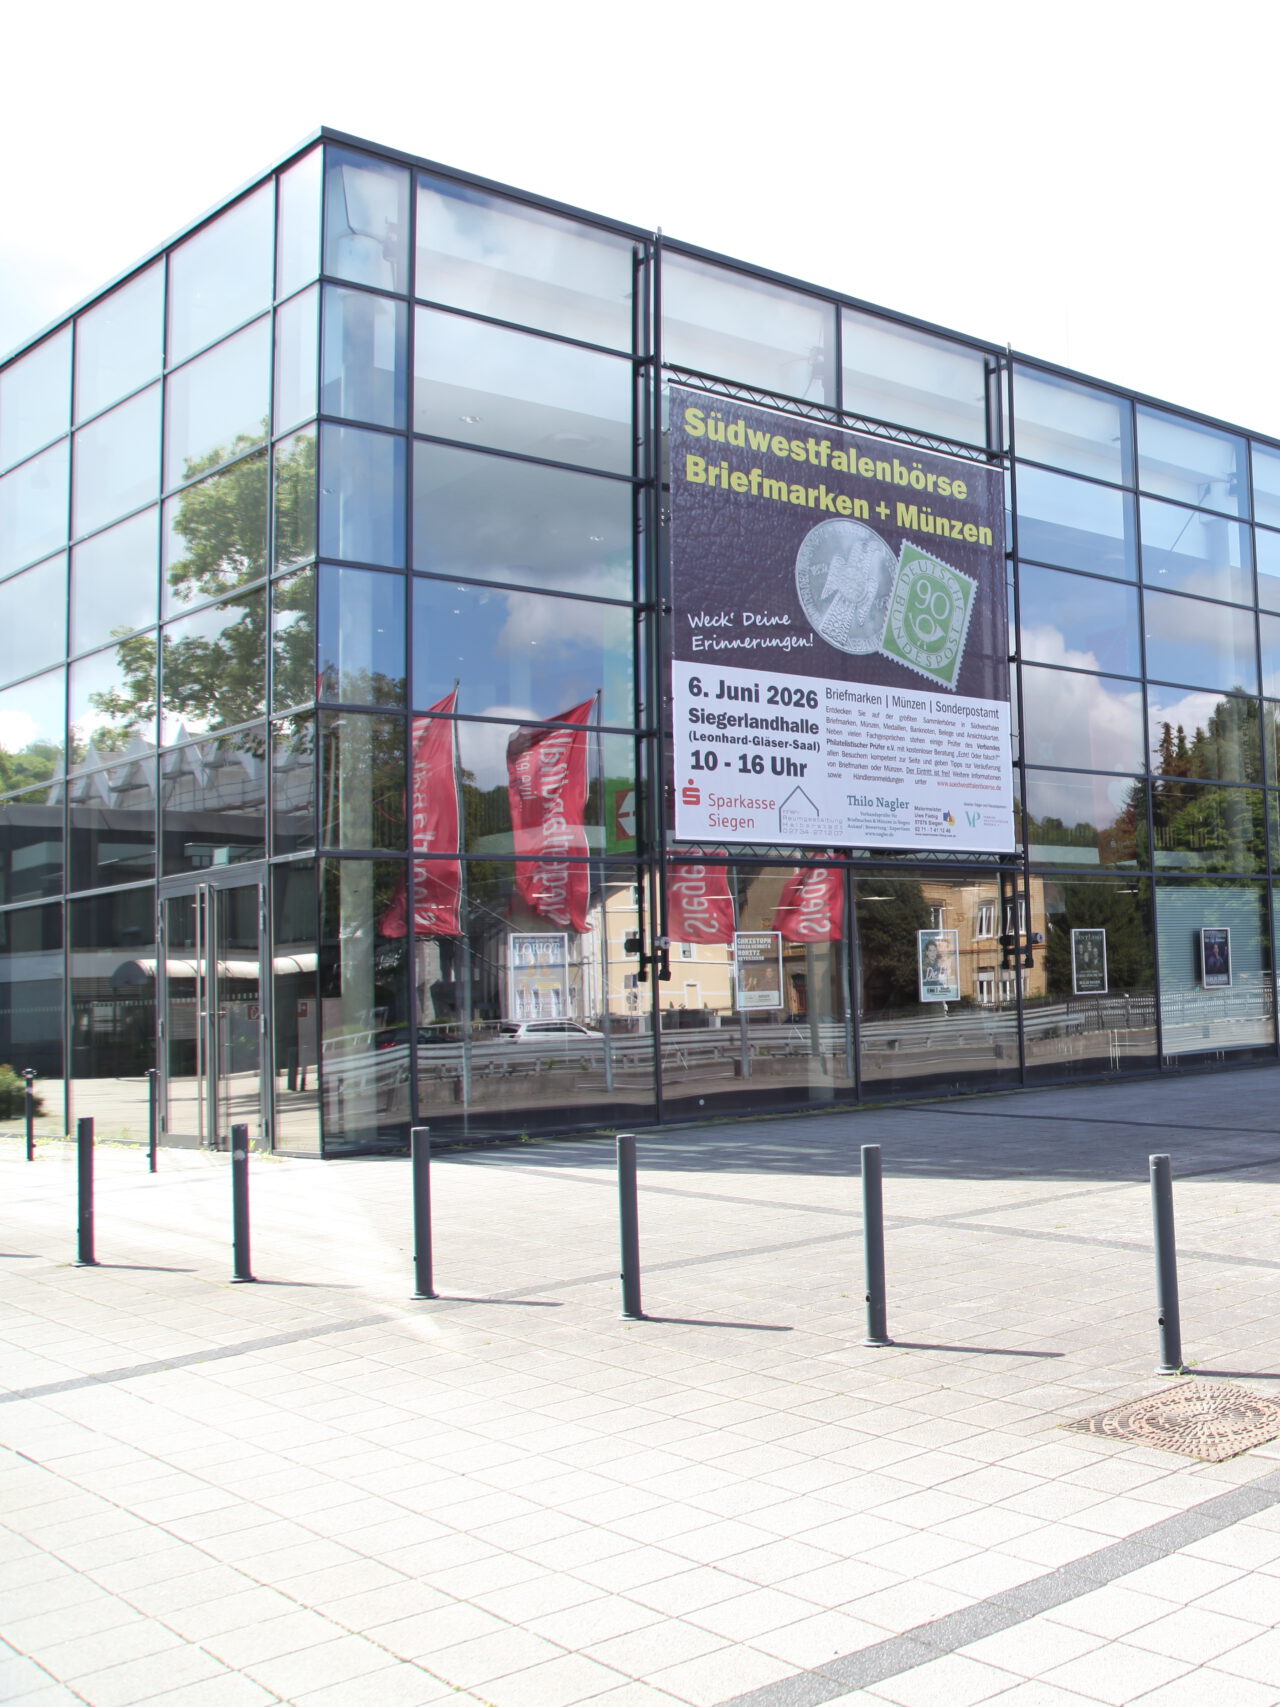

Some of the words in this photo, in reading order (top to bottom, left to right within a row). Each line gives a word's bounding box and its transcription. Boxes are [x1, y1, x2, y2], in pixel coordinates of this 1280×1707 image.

[683, 407, 968, 500] Südwestfalenbörse
[685, 454, 870, 520] Briefmarken
[875, 505, 890, 521] +
[896, 502, 993, 547] Münzen
[915, 580, 950, 620] 90
[743, 611, 791, 627] Deine
[691, 634, 814, 652] Erinnerungen!
[688, 676, 710, 698] 6.
[715, 679, 760, 704] Juni
[766, 685, 819, 709] 2026
[825, 687, 882, 706] Briefmarken
[892, 695, 927, 710] Münzen
[936, 700, 1000, 719] Sonderpostamt
[688, 707, 820, 735] Siegerlandhalle
[688, 730, 821, 754] (Leonhard-Gläser-Saal)
[826, 738, 868, 749] Philatelistischer
[869, 742, 885, 751] Prüfer
[690, 750, 718, 771] 10
[738, 754, 765, 775] 16
[771, 756, 808, 778] Uhr
[708, 793, 776, 811] Sparkasse
[846, 794, 874, 807] Thilo
[875, 796, 910, 813] Nagler
[708, 813, 756, 832] Siegen
